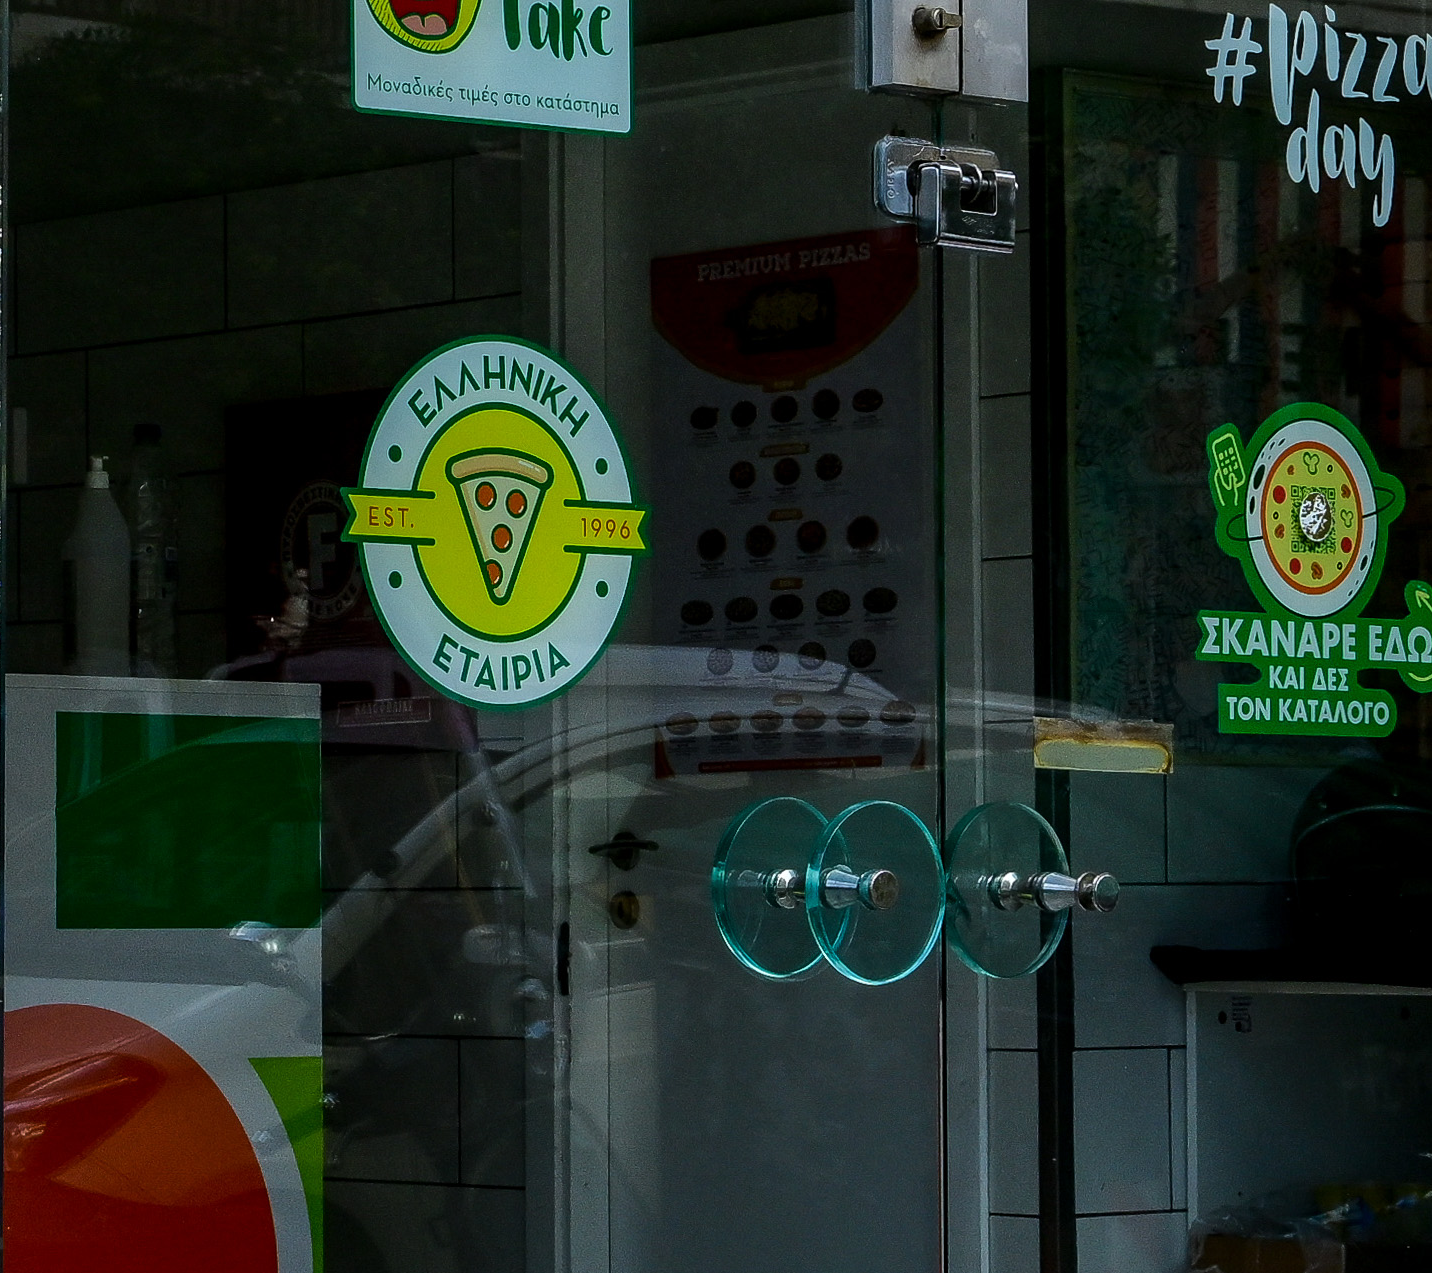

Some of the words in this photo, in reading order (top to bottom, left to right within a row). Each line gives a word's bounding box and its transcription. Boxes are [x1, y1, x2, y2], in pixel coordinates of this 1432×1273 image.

[368, 73, 453, 102] Μοναδικές
[459, 85, 498, 106] τιμές
[504, 93, 530, 106] στο
[537, 93, 619, 118] κατάστημα
[1285, 88, 1396, 229] day
[697, 252, 792, 282] PREMIUM
[799, 242, 871, 268] PIZZAS
[407, 355, 591, 438] ΕΛΛΗΝΙΚΗ
[369, 505, 415, 529] EST.
[581, 517, 631, 540] 1996
[432, 633, 571, 692] ΕΤΑΙΡΙΑ
[1202, 617, 1355, 659] ΣΚΑΝΑΡΕ
[1369, 625, 1432, 663] ΕΔΩ
[1270, 666, 1304, 689] ΚΑΙ
[1312, 668, 1348, 691] ΔΕΣ
[1227, 697, 1270, 720] ΤΟΝ
[1279, 699, 1389, 725] ΚΑΤΑΛΟΓΟ
